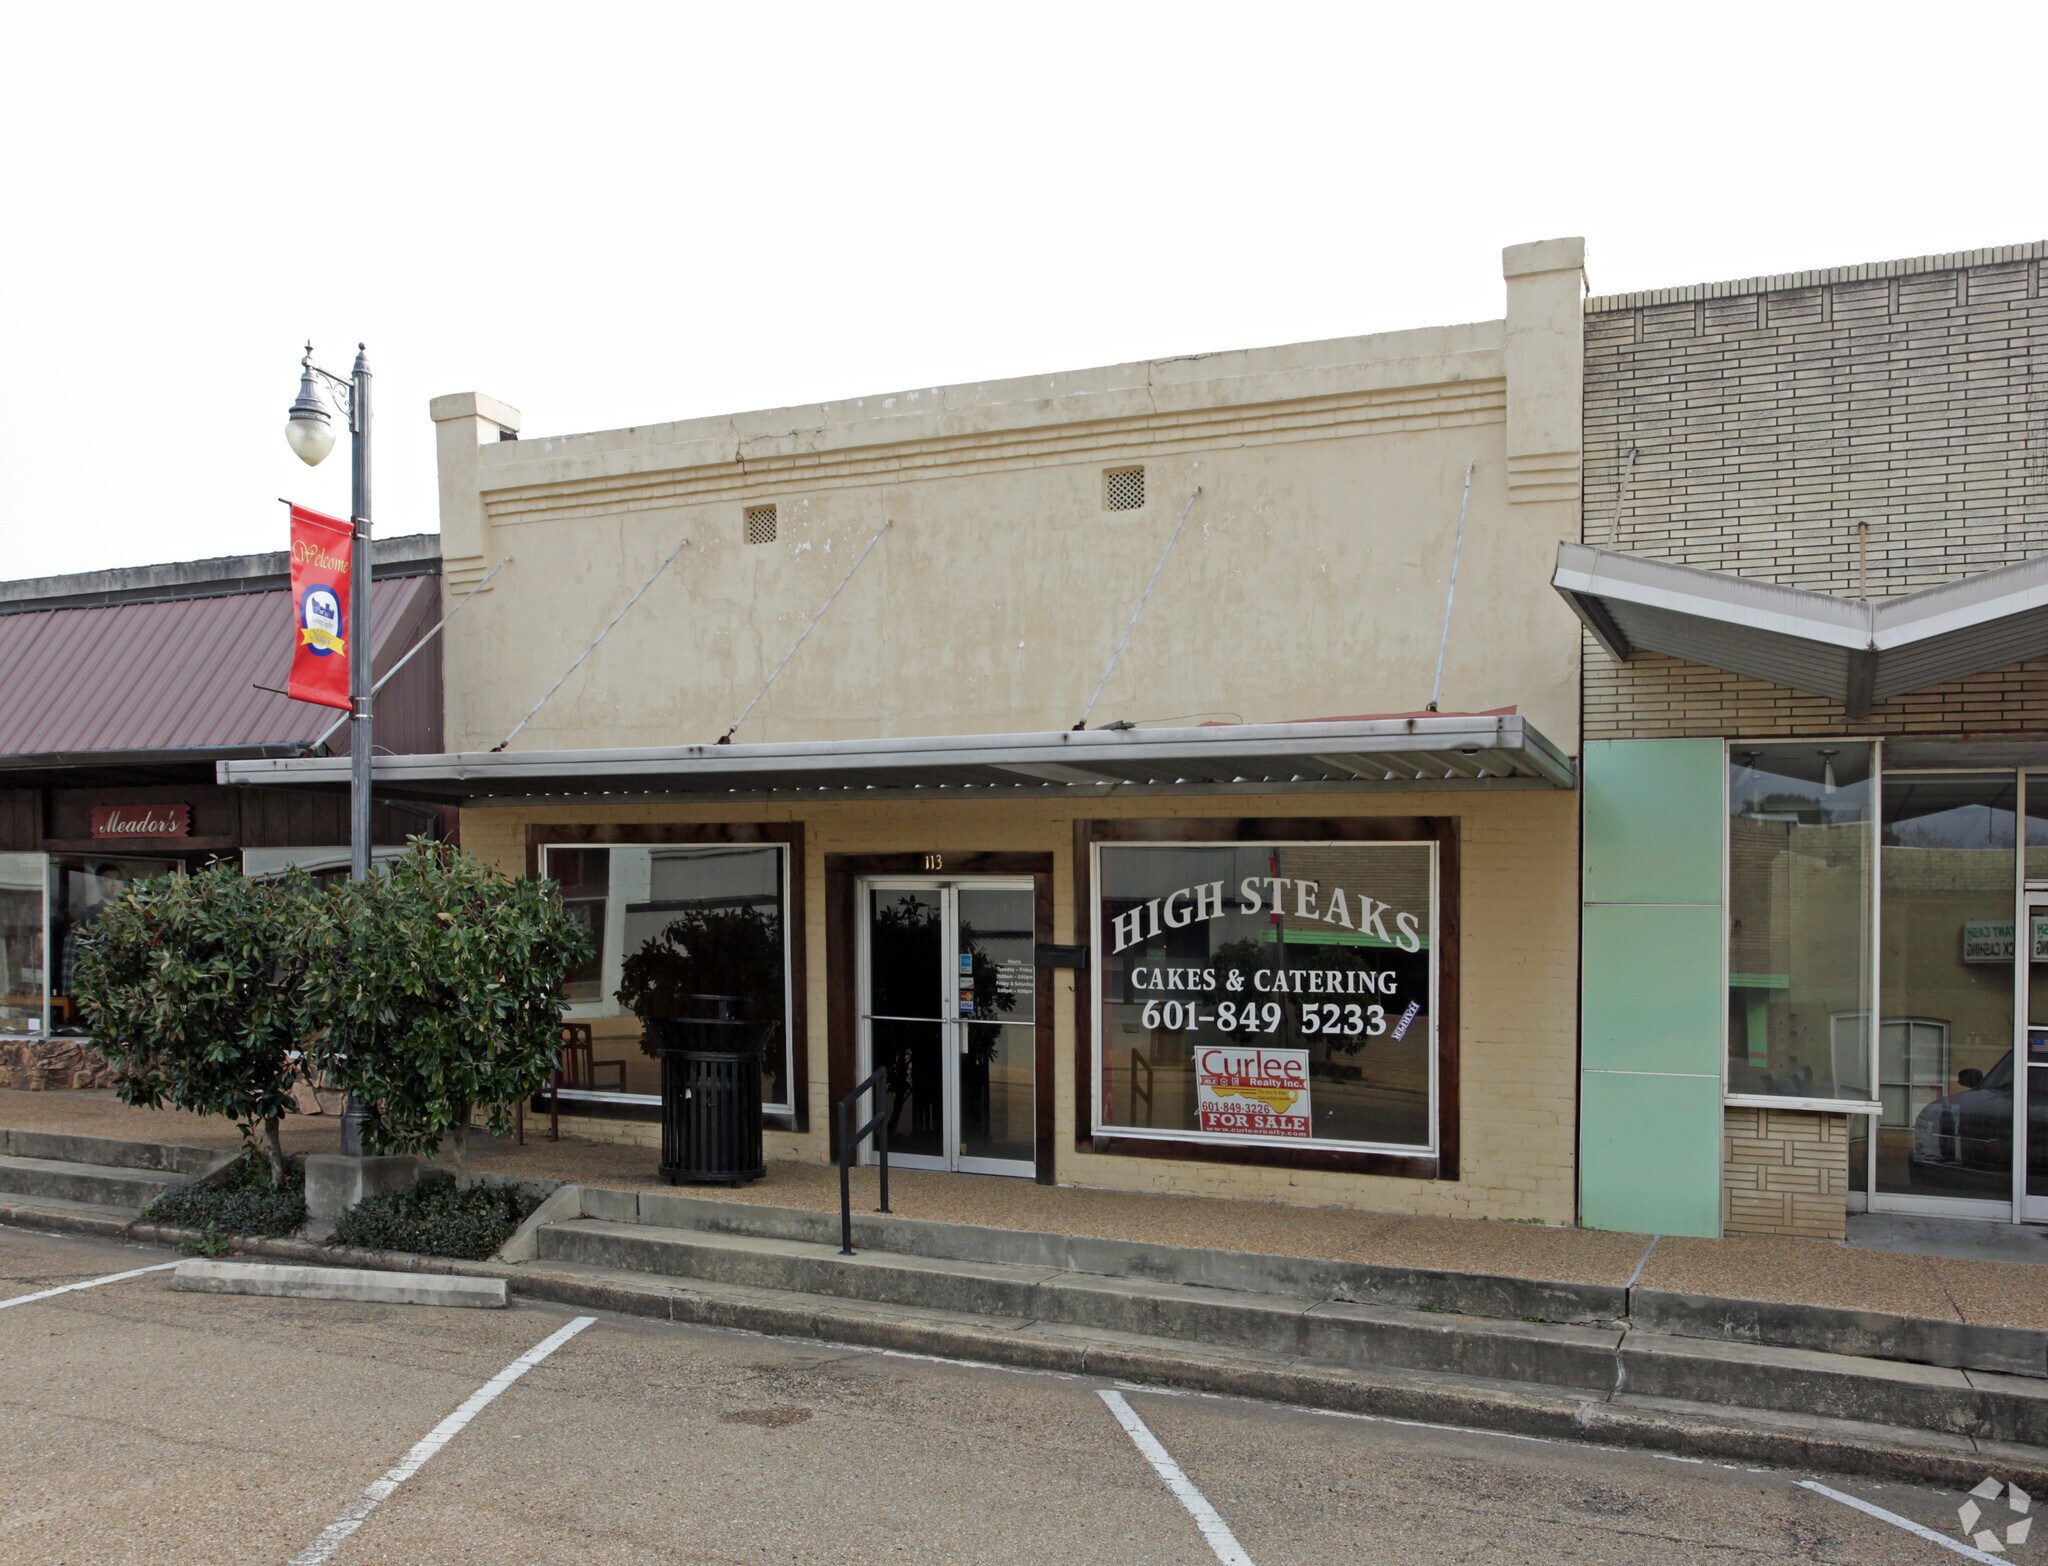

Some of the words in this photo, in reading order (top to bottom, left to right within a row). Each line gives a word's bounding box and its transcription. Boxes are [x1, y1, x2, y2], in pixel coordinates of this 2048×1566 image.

[293, 540, 349, 575] Welcome
[99, 810, 181, 834] Meador's
[925, 854, 943, 870] 113
[1111, 880, 1225, 955] HIGH
[1240, 876, 1421, 953] STEAKS
[1131, 967, 1216, 991] CAKES
[1225, 968, 1245, 992] &
[1253, 969, 1398, 995] CATERING
[1141, 1000, 1282, 1034] 601-849
[1301, 1002, 1387, 1036] 5233
[1392, 1000, 1420, 1041] HARPER
[1201, 1050, 1303, 1079] Curlee
[1250, 1078, 1281, 1089] Realty
[1284, 1080, 1303, 1089] Inc.
[1202, 1101, 1270, 1115] 601-849-3226
[1206, 1127, 1307, 1136] www.curleerealty.com
[1208, 1113, 1249, 1127] FOR
[1254, 1115, 1305, 1130] SALE
